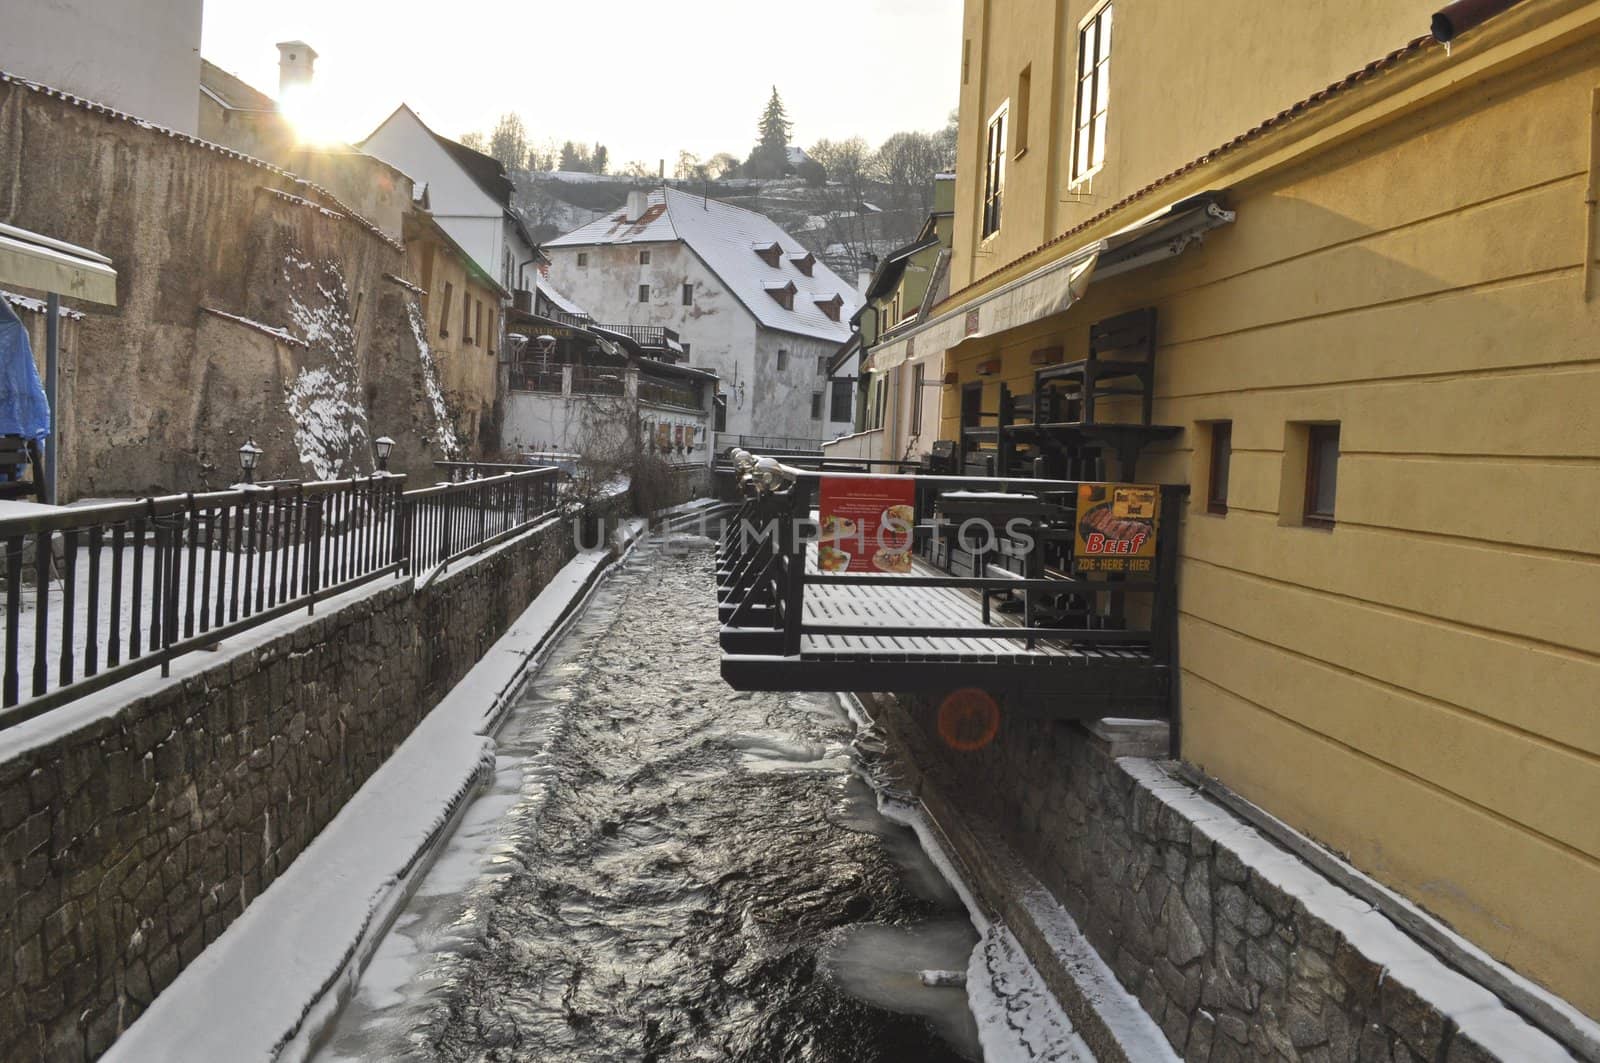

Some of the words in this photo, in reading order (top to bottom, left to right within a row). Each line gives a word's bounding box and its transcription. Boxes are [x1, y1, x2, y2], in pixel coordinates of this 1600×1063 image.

[1078, 558, 1096, 570] ZDE
[1100, 559, 1125, 570] HERE
[1129, 559, 1151, 571] HIER
